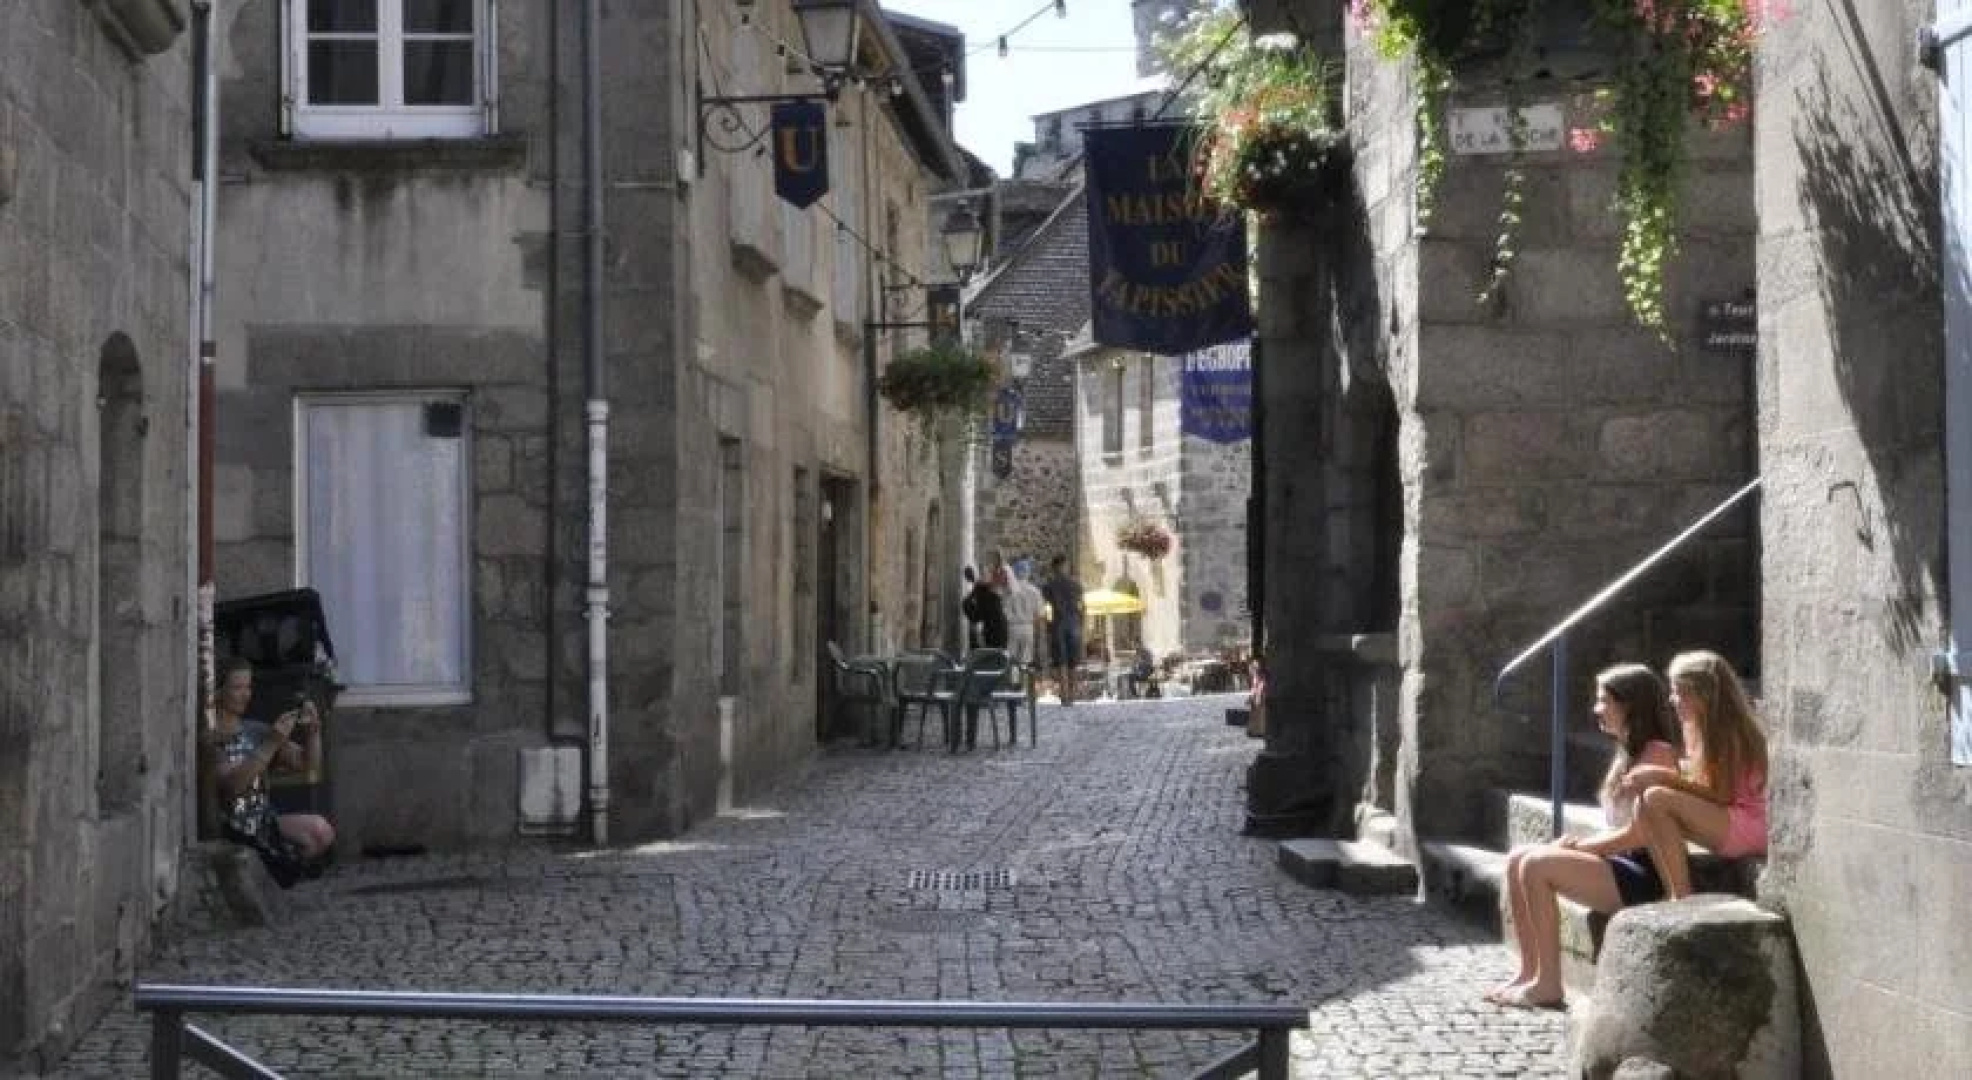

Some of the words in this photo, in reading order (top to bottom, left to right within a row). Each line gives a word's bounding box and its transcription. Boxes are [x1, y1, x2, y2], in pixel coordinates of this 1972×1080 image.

[777, 127, 818, 171] U
[1455, 132, 1474, 148] DE
[1480, 130, 1501, 146] LA
[1149, 241, 1188, 267] DU
